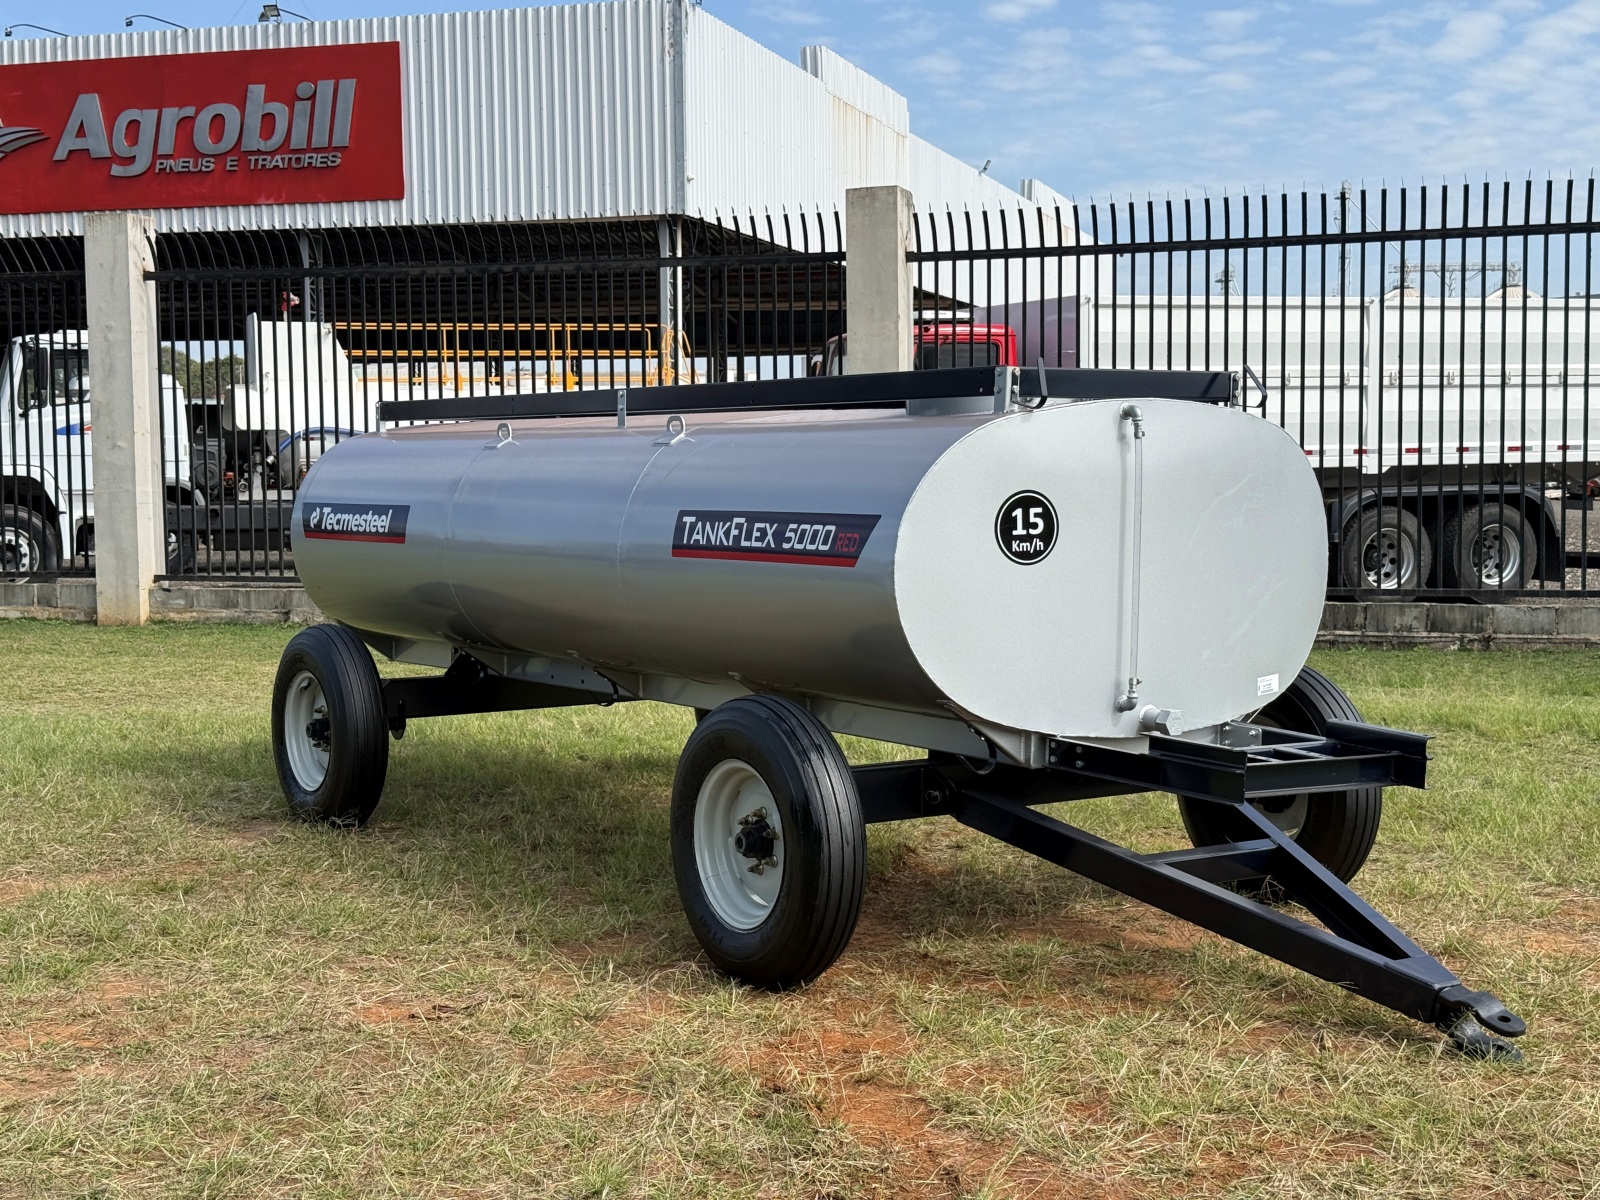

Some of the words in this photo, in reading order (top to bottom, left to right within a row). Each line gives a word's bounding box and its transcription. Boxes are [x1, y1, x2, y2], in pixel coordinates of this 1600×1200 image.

[53, 79, 357, 177] Agrobill
[155, 157, 216, 174] PNEUS
[226, 156, 239, 171] E
[247, 152, 342, 170] TRATORES
[321, 507, 393, 533] Tecmesteel
[1011, 507, 1044, 536] 15
[782, 523, 836, 551] 5000
[835, 533, 860, 553] RED
[1012, 537, 1044, 554] Km/h
